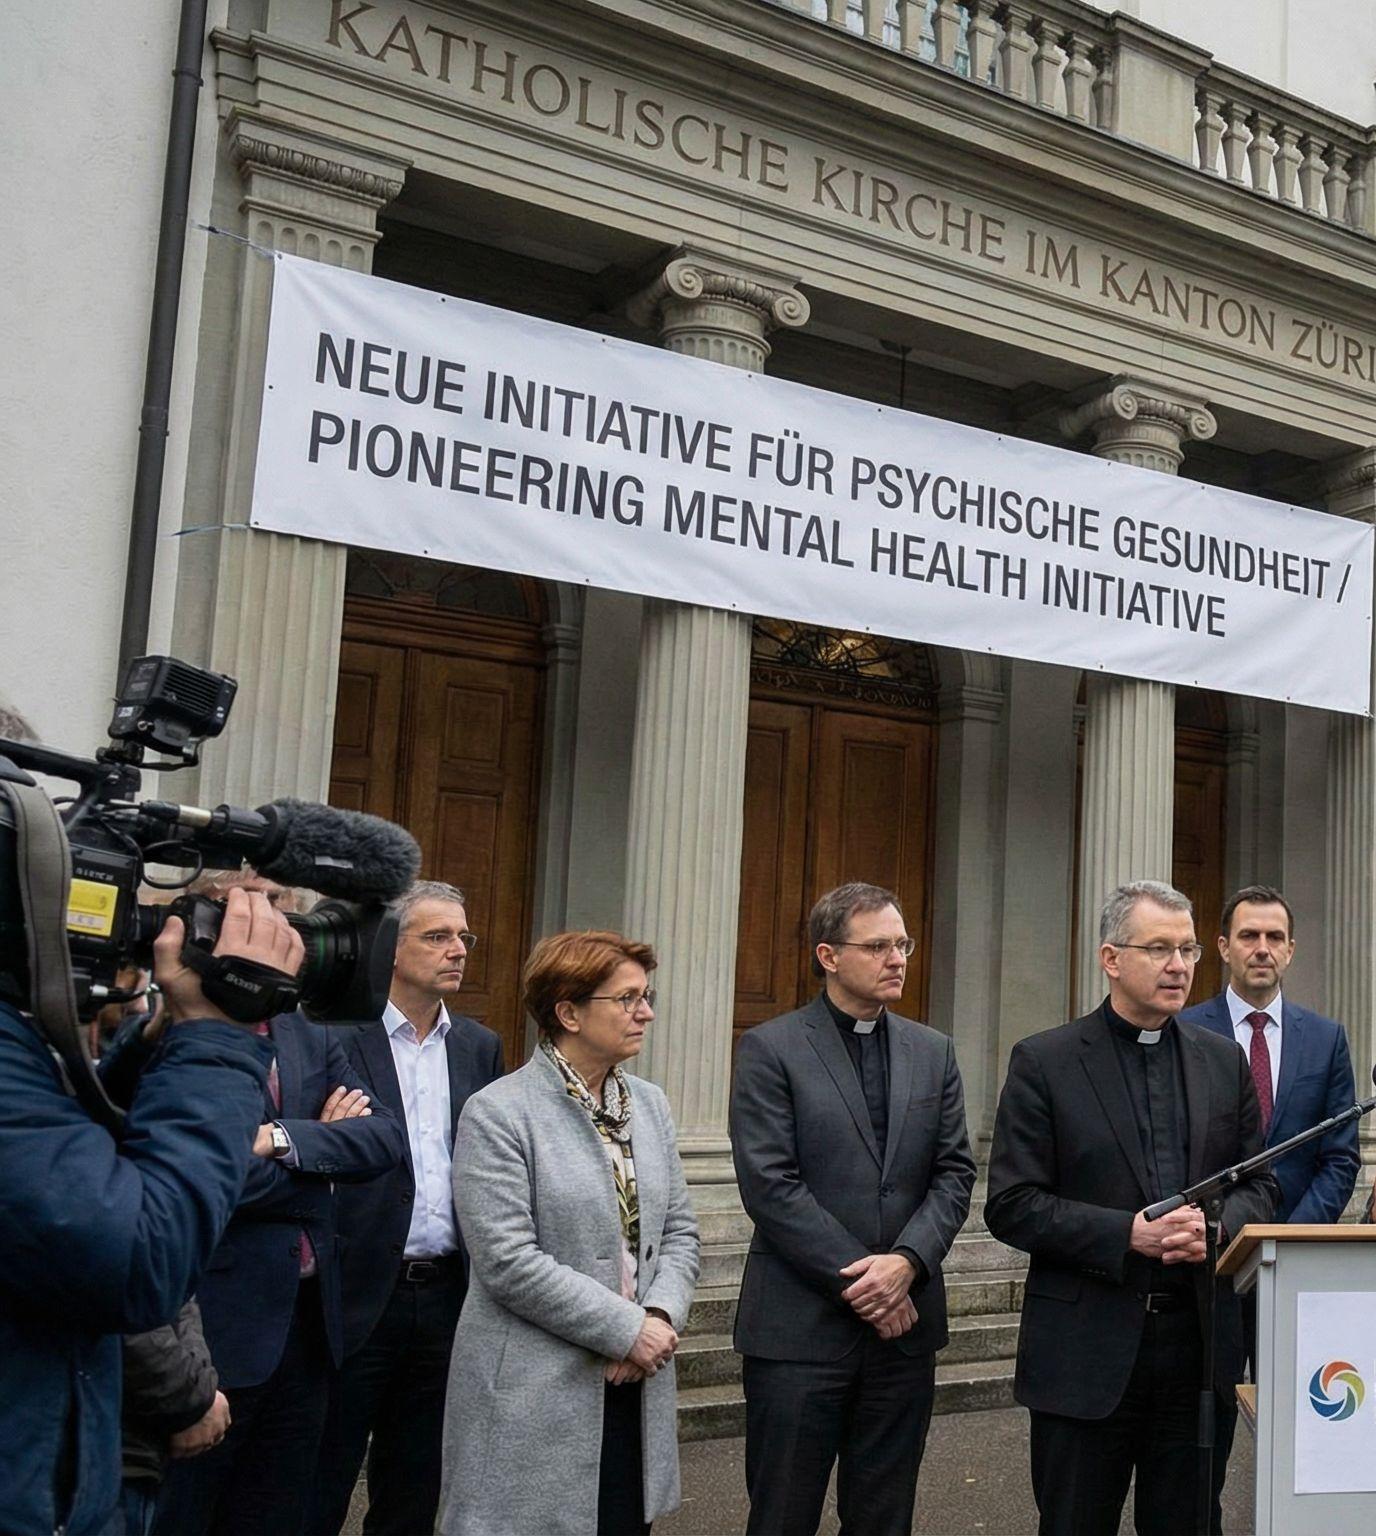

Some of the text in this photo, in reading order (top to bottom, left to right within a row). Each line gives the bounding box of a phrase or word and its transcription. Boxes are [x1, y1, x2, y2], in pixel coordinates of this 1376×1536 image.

[325, 0, 789, 192] KATHOLISCHE
[812, 156, 1005, 264] KIRCHE
[1025, 229, 1081, 288] IM
[1100, 254, 1276, 351] KANTON
[308, 410, 1226, 638] PIONEERING MENTAL HEALTH INITIATIVE
[315, 332, 1352, 603] NEUE INITIATIVE FÜR PSYCHISCHE GESUNDHEIT /
